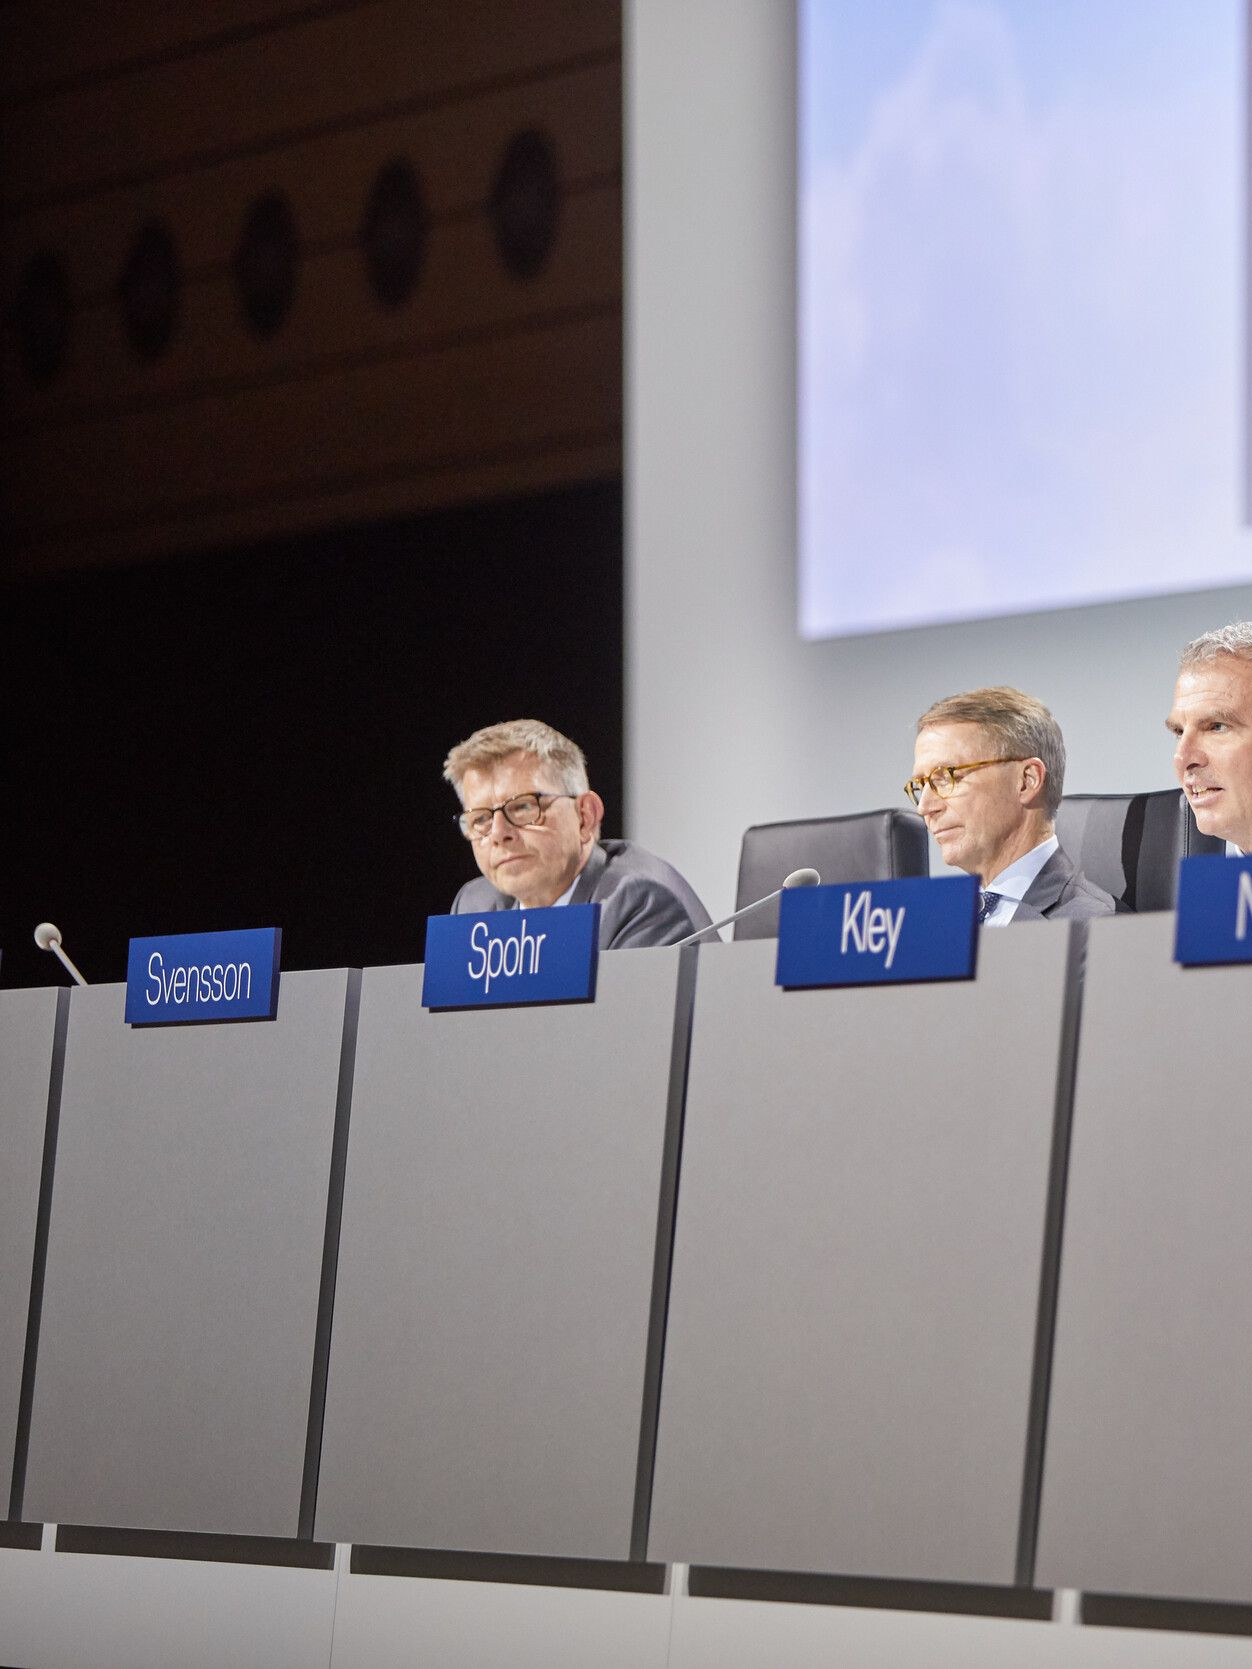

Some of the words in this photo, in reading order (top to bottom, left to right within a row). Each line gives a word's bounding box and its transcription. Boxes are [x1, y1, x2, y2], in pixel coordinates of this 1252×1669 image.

[468, 918, 547, 994] Spohr
[840, 890, 906, 970] Kley
[145, 951, 252, 1006] Svensson
